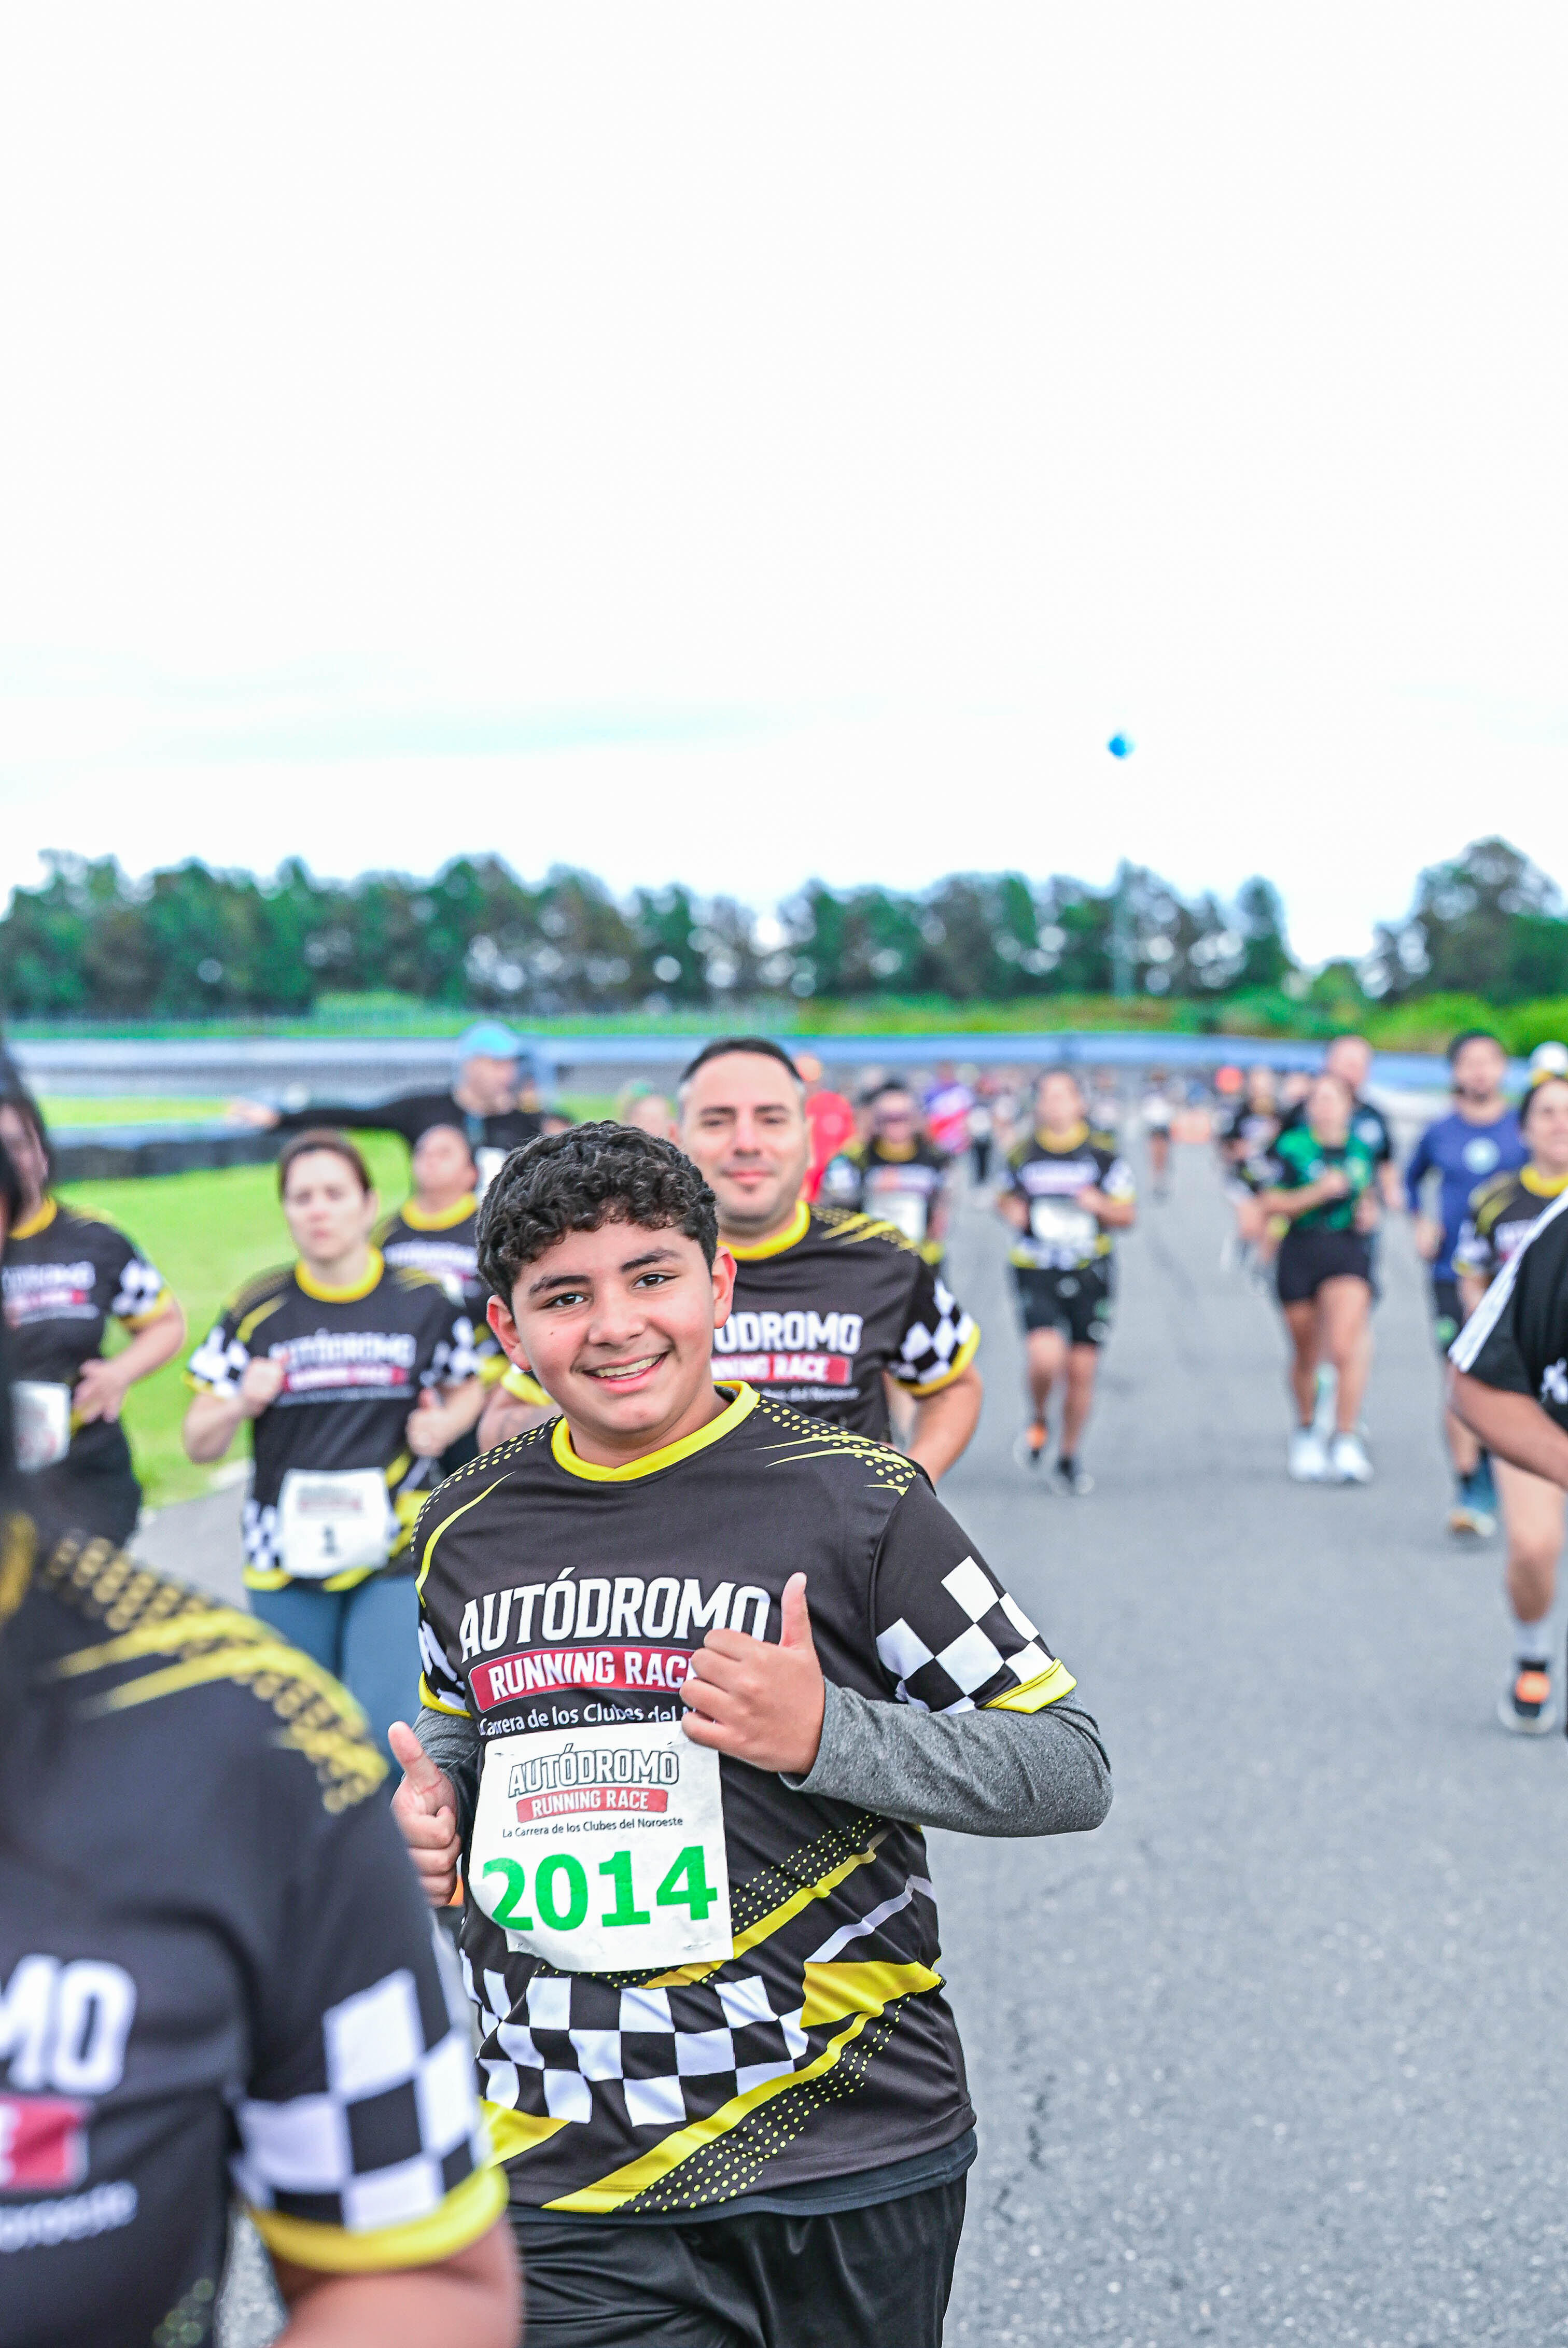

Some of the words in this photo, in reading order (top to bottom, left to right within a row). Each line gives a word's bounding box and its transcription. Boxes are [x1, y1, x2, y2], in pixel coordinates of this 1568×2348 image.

[714, 1310, 864, 1355] ODROMO
[459, 1567, 771, 1664] AUTÓDROMO
[488, 1651, 615, 1701] RUNNING
[478, 1715, 526, 1736] Carrera
[527, 1708, 549, 1729] de
[552, 1706, 579, 1726] los
[584, 1703, 644, 1723] Clubes
[648, 1705, 676, 1722] del
[508, 1743, 680, 1798] AUTÓDROMO
[502, 1828, 512, 1838] La
[515, 1826, 549, 1837] Carrera
[552, 1823, 564, 1833] de
[567, 1822, 580, 1833] los
[583, 1820, 617, 1832] Clubes
[620, 1819, 635, 1829] del
[638, 1817, 683, 1827] Noroeste
[531, 1790, 601, 1818] RUNNING
[606, 1790, 649, 1810] RACE
[482, 1845, 718, 1932] 2014
